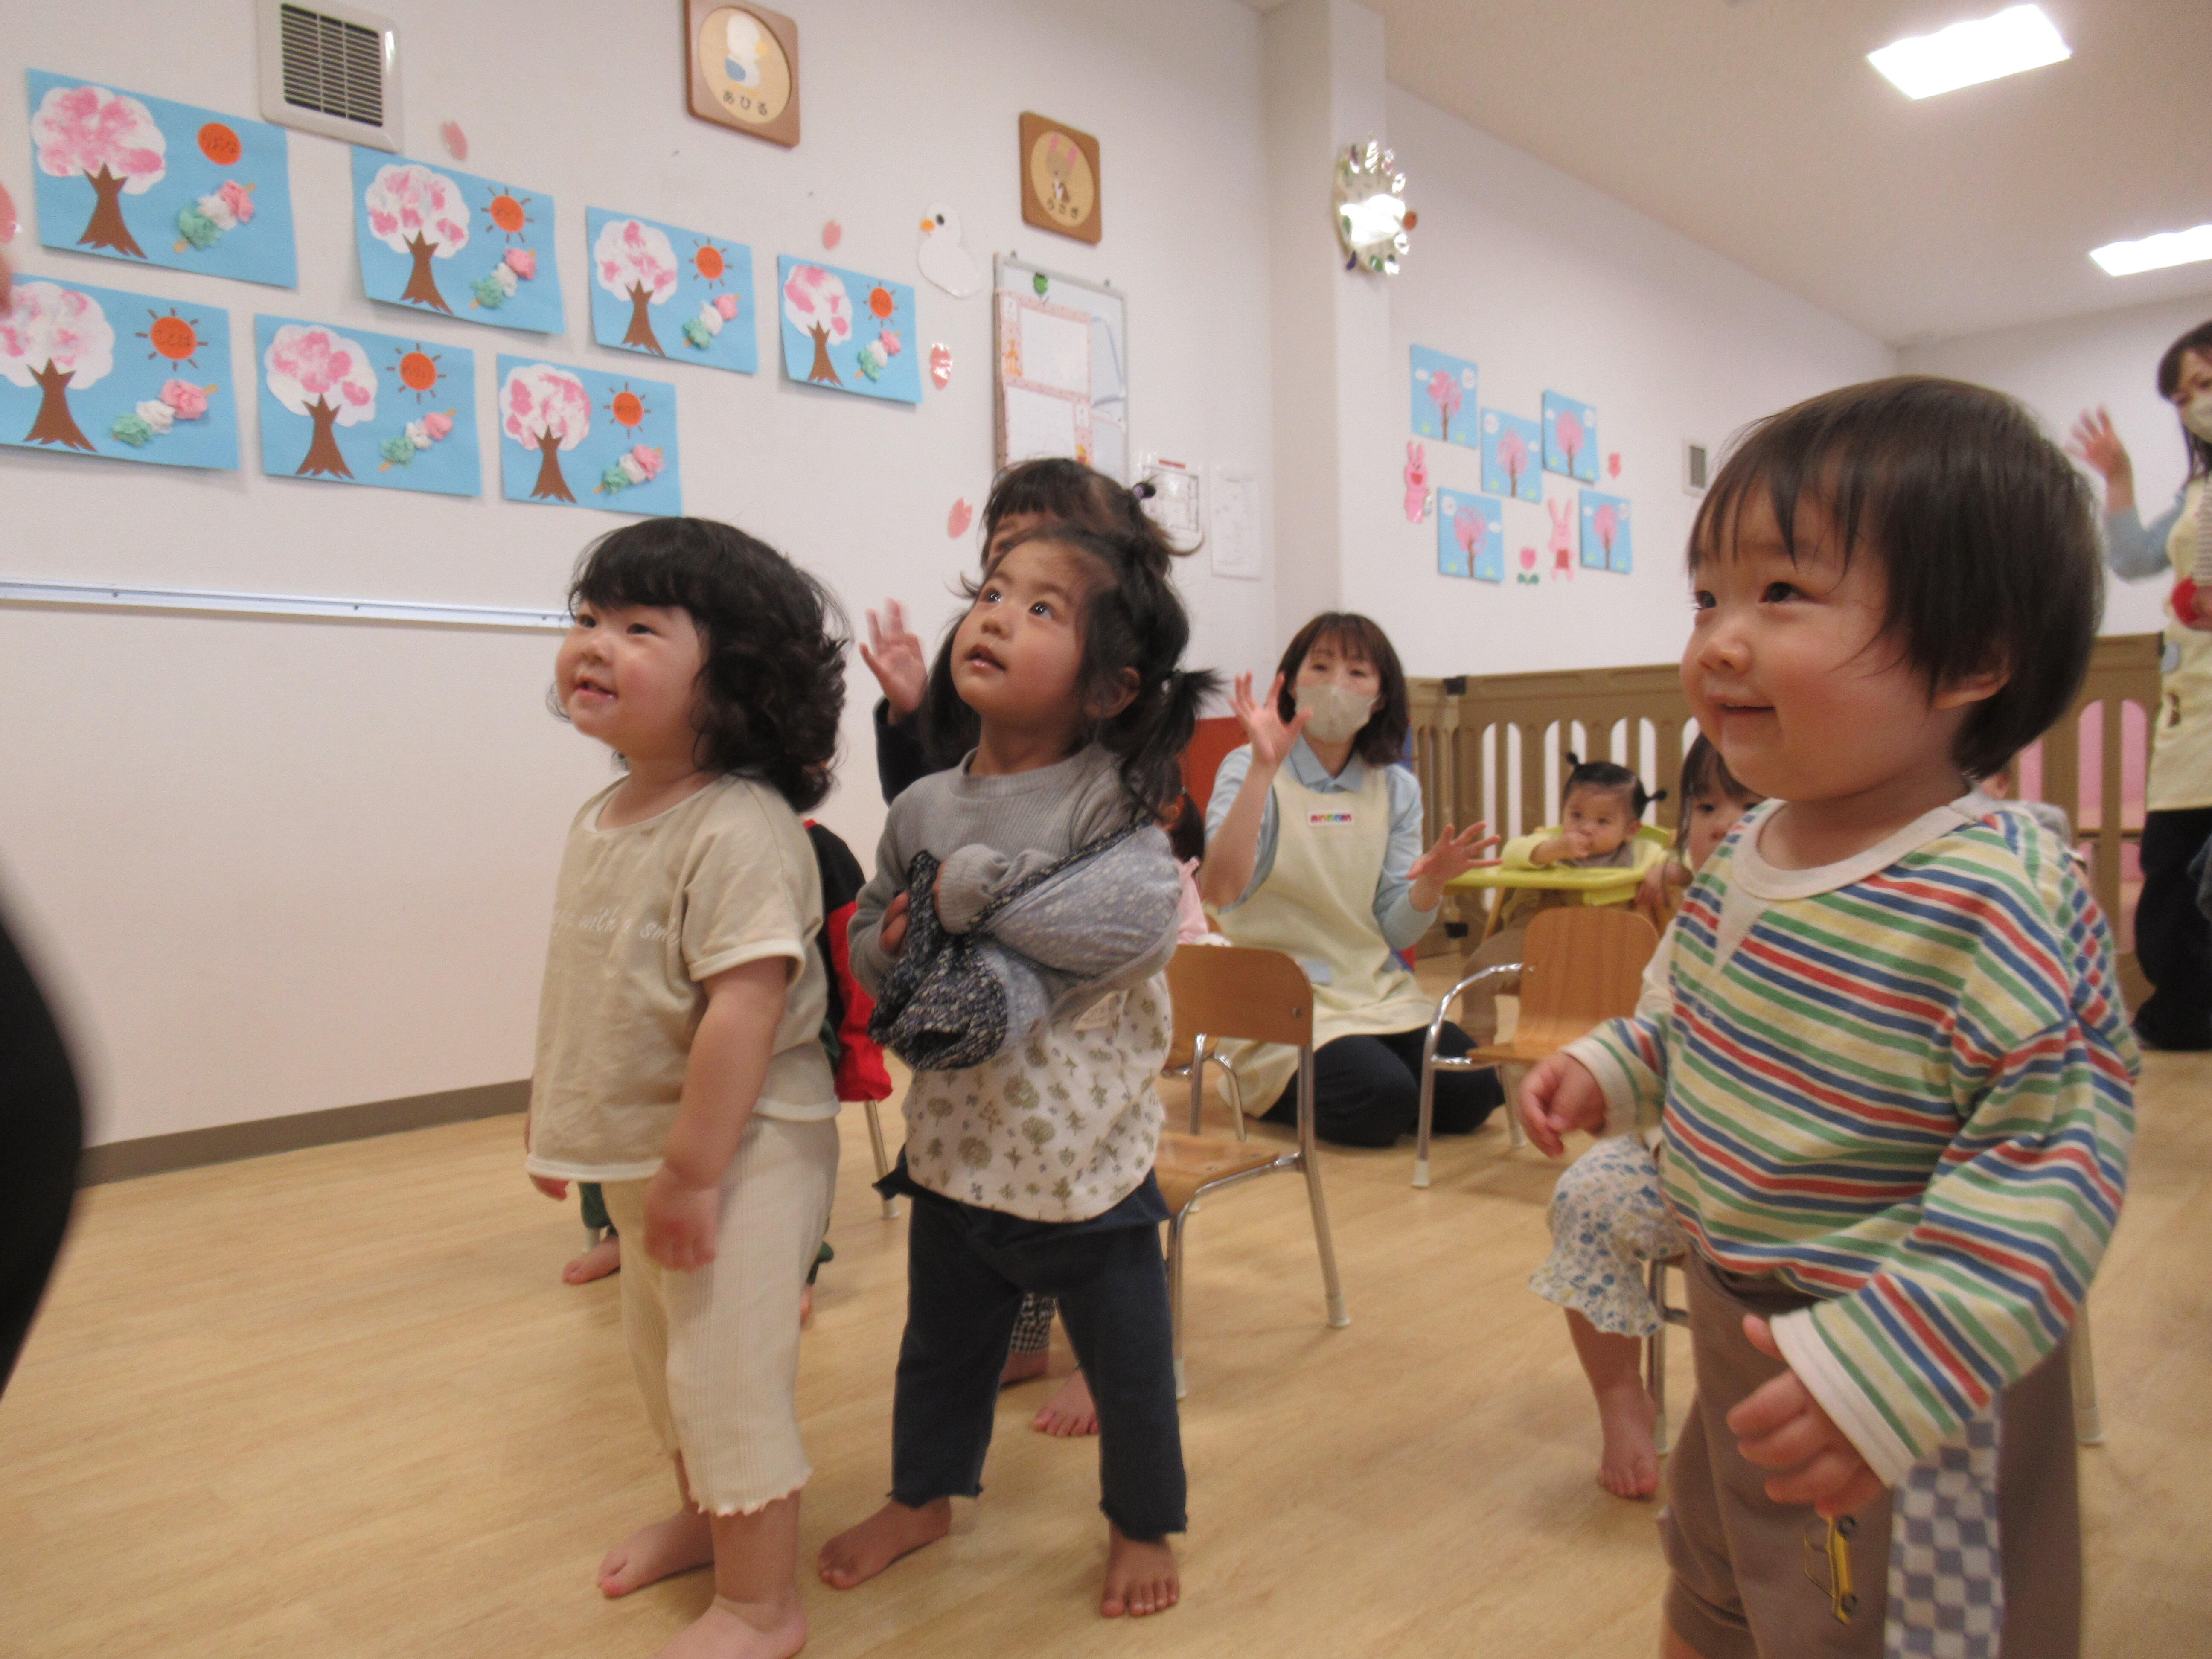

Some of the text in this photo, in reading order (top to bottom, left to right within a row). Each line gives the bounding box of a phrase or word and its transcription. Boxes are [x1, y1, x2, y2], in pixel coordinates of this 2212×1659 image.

[723, 90, 767, 116] あひる
[1046, 198, 1079, 219] うさぎ
